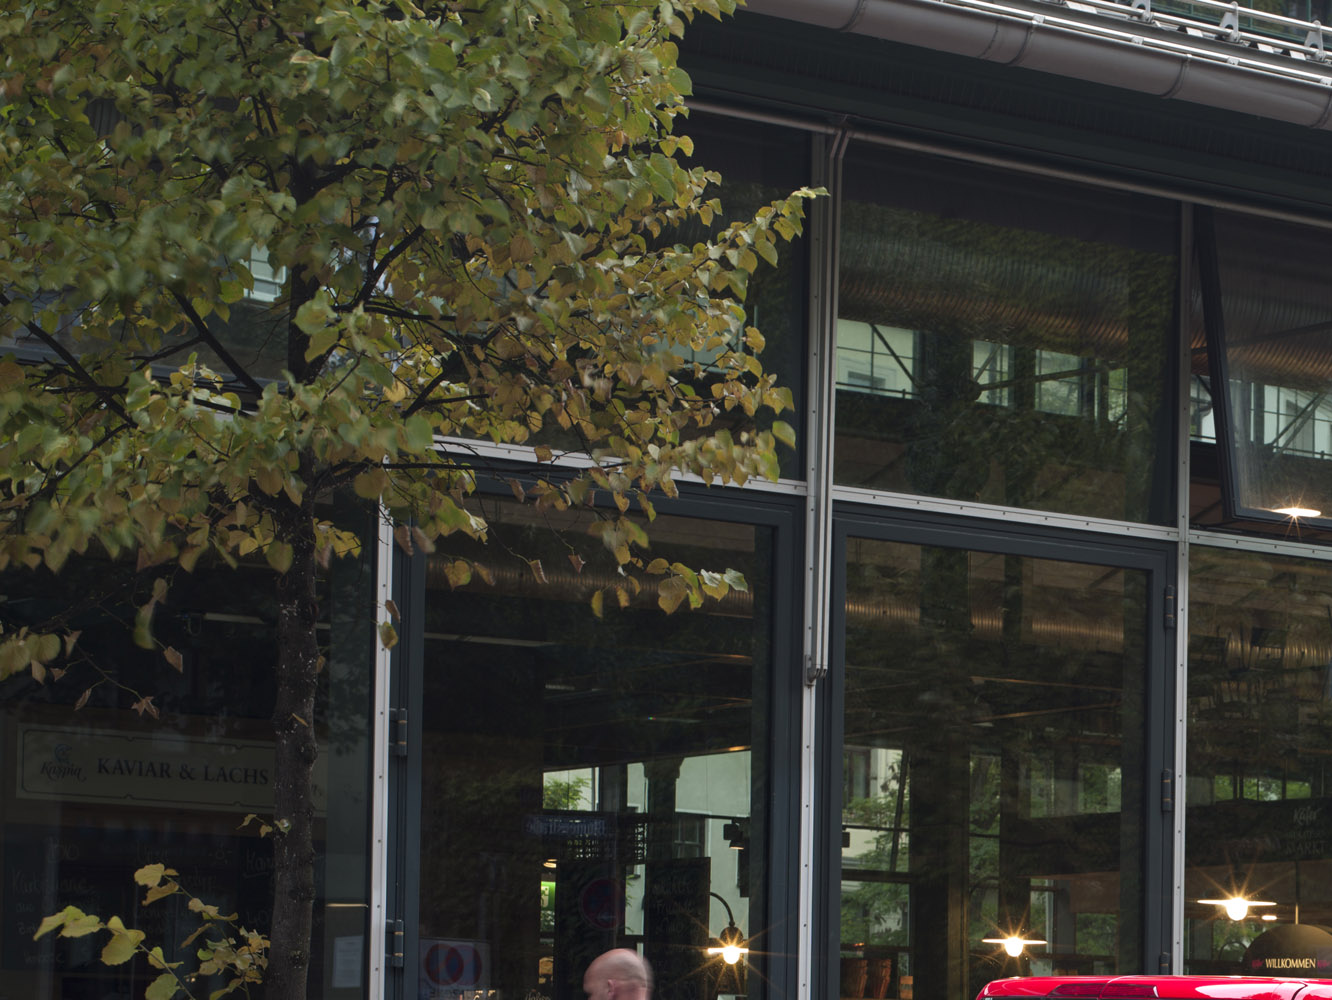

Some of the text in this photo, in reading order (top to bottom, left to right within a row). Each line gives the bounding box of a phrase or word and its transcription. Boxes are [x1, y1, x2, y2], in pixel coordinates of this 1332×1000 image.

[97, 757, 270, 786] KAVIAR & LACHS
[1265, 957, 1316, 969] WILLKOMMEN
